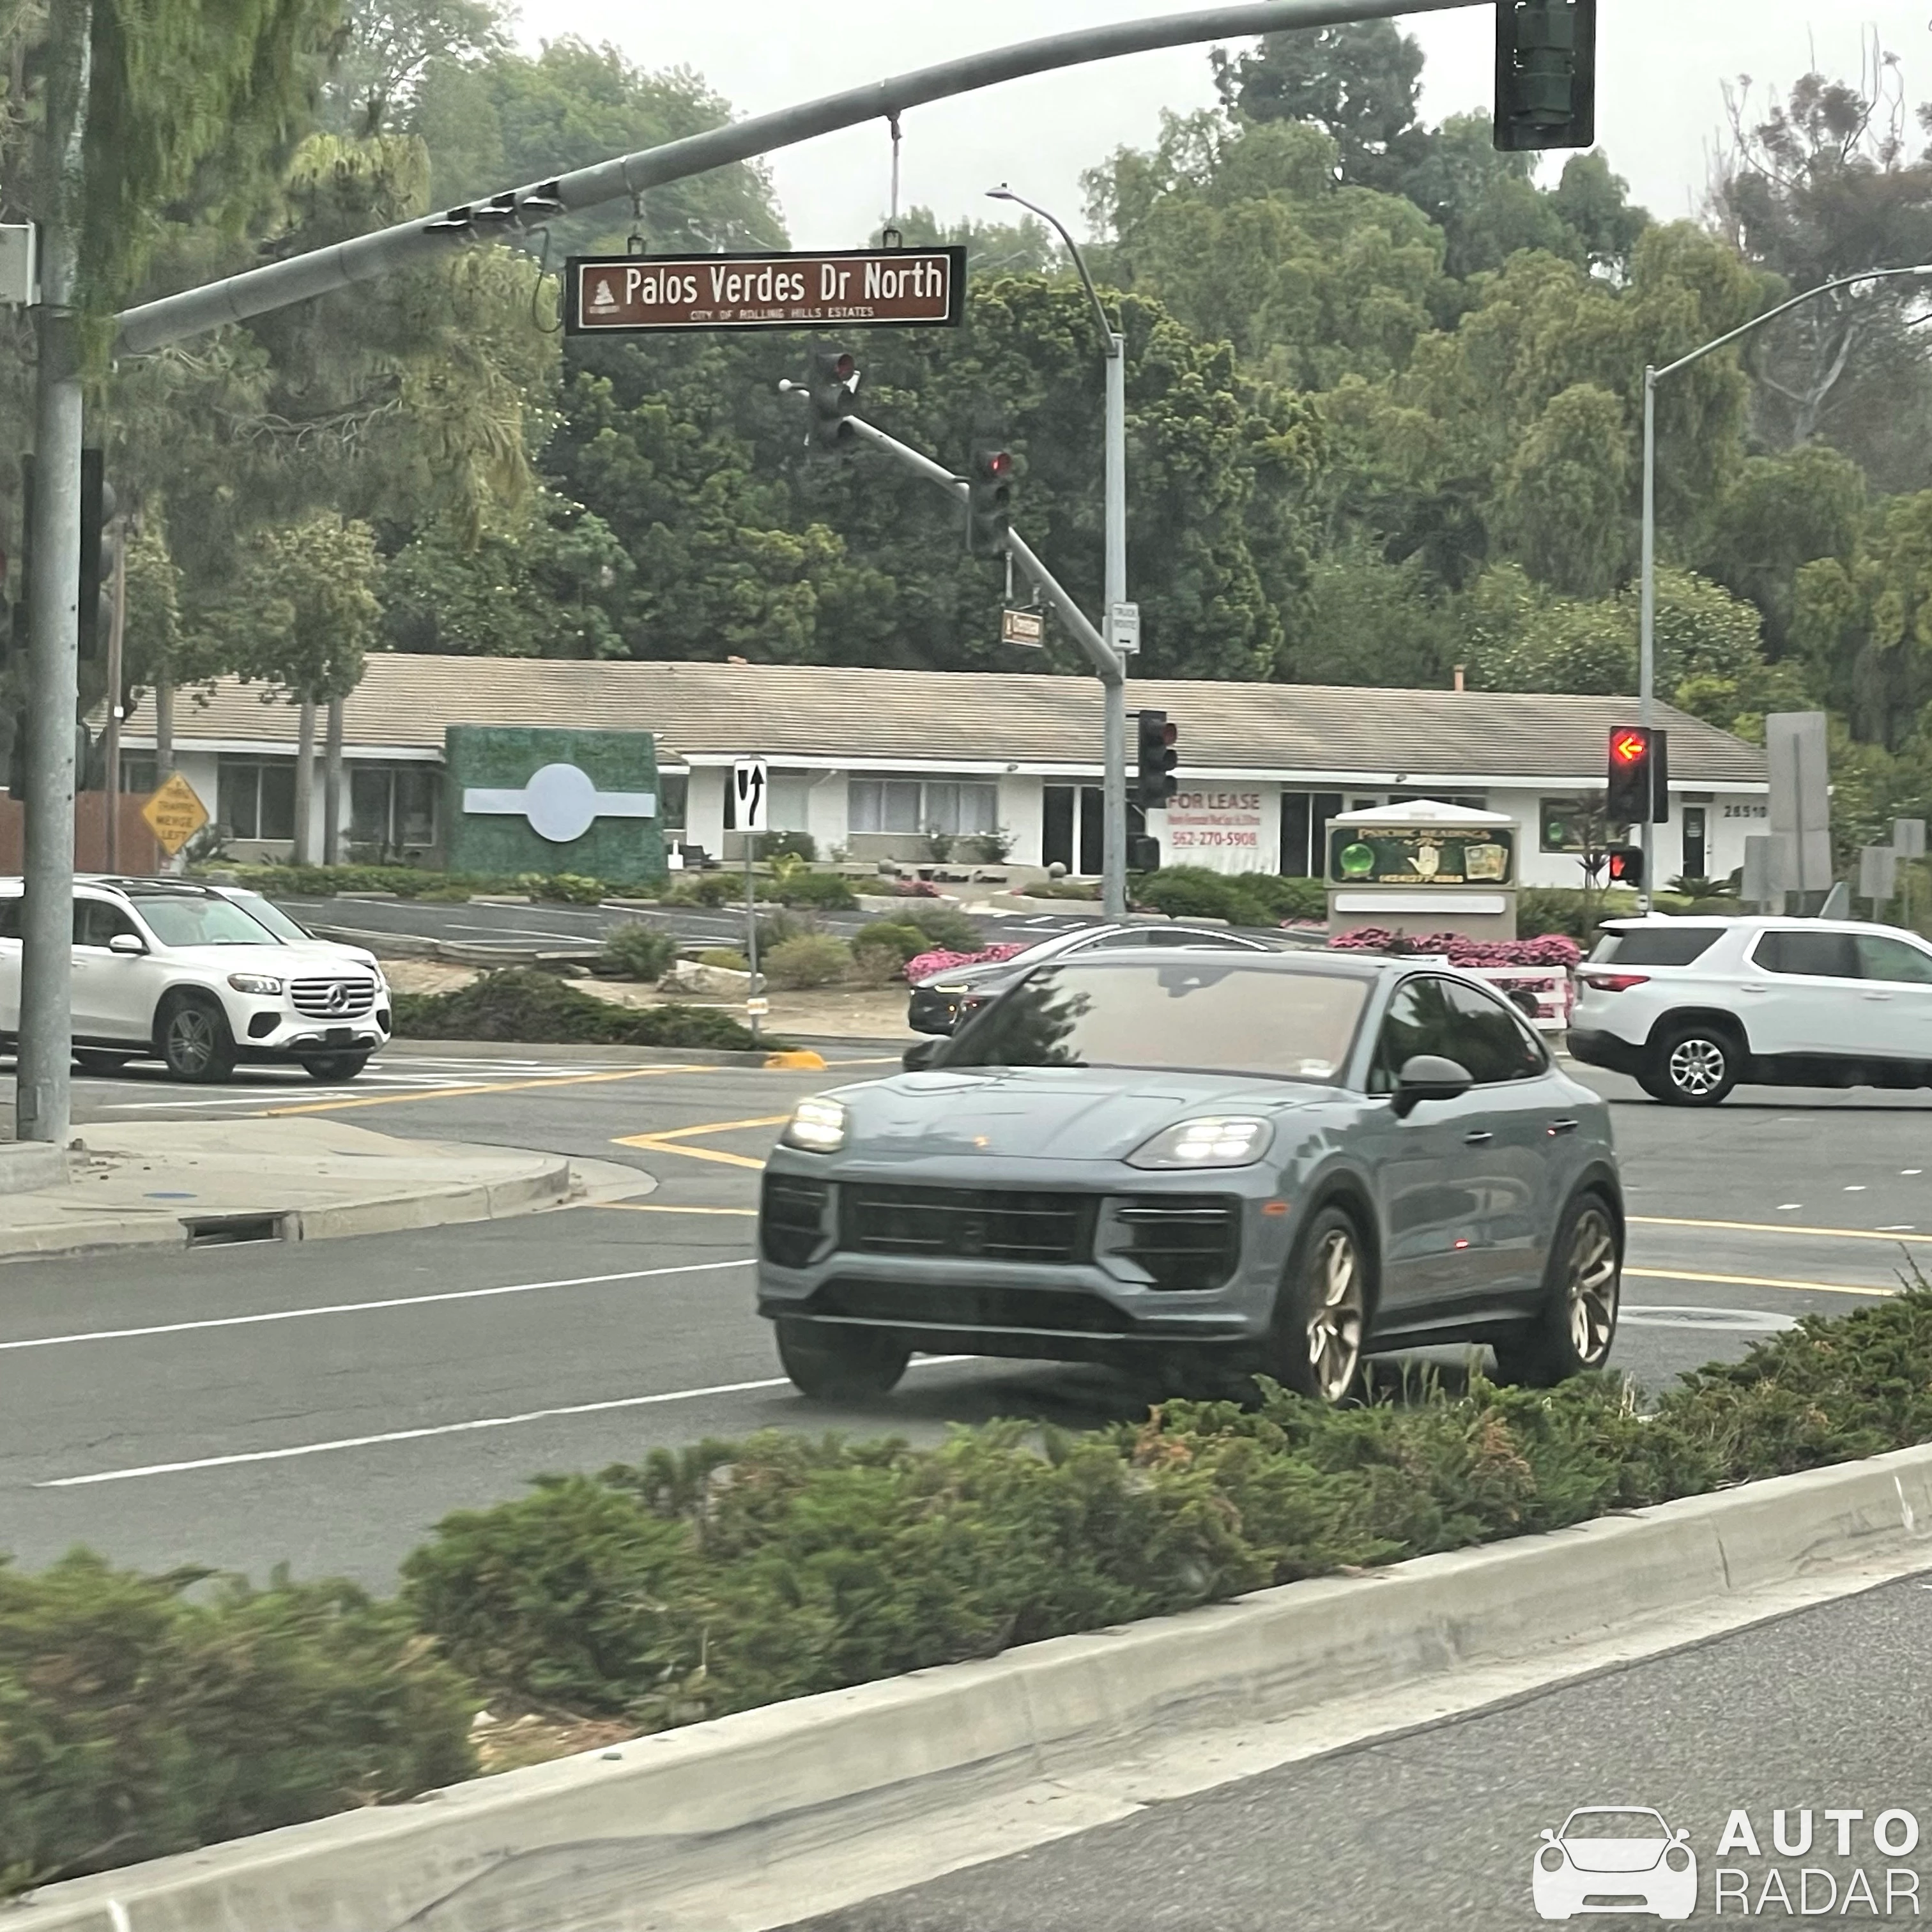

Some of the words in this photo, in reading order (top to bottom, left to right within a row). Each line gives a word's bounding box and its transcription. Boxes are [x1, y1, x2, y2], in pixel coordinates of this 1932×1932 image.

[625, 268, 698, 305] Palos
[710, 265, 805, 303] Verdes
[821, 263, 851, 300] Dr
[864, 261, 942, 299] North
[691, 310, 712, 321] CITY
[719, 310, 733, 320] OF
[740, 309, 785, 319] ROLLING
[791, 307, 822, 318] HILLS
[828, 306, 875, 318] ESTATES
[158, 801, 194, 813] TRAFFIC
[1169, 793, 1204, 809] FOR
[1208, 793, 1260, 809] LEASE
[156, 815, 194, 828] MERGE
[162, 830, 187, 840] LEFT
[1172, 831, 1257, 846] 562-270-5908
